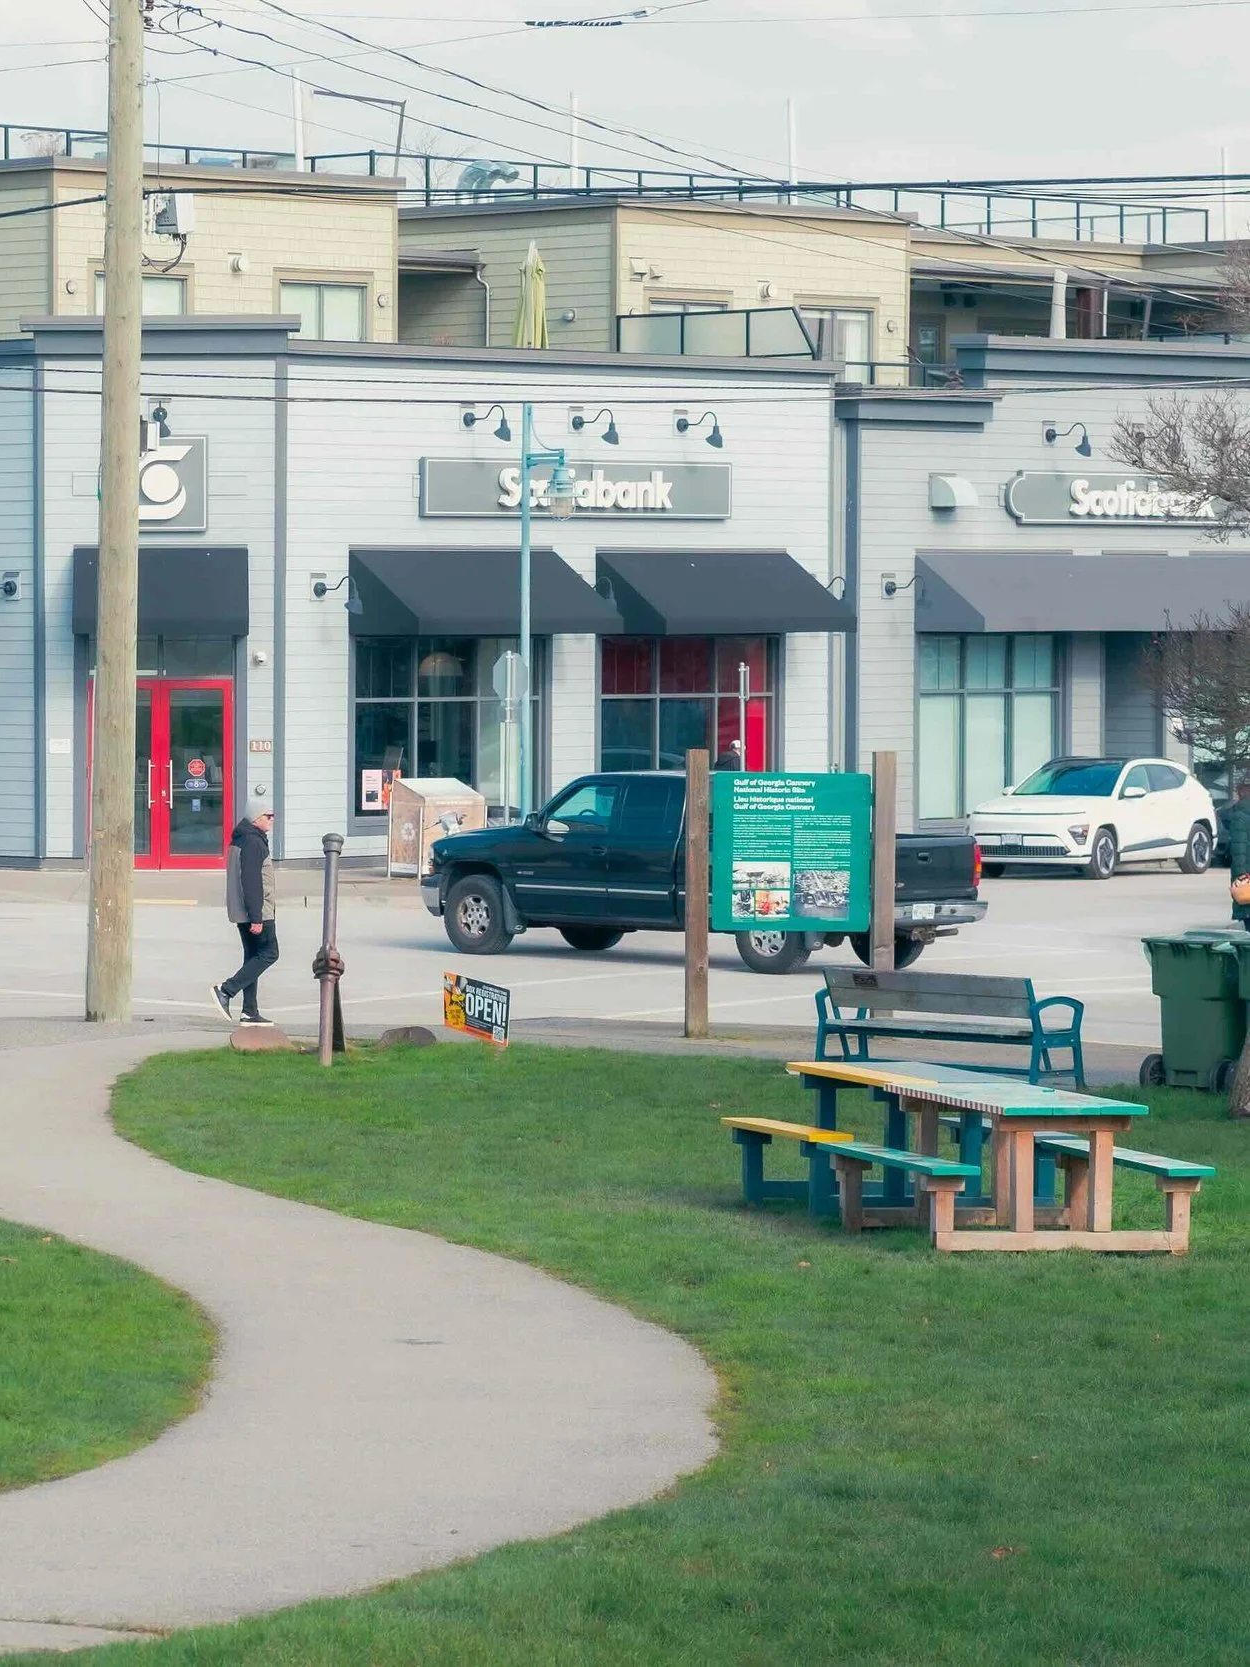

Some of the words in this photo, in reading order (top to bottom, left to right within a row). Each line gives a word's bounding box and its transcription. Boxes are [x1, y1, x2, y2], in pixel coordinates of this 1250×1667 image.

[498, 467, 673, 509] Soabank
[251, 742, 271, 750] 110
[758, 779, 785, 787] Georgia
[786, 779, 816, 788] Cannery
[786, 804, 816, 812] Cannery
[465, 992, 507, 1027] OPEN!
